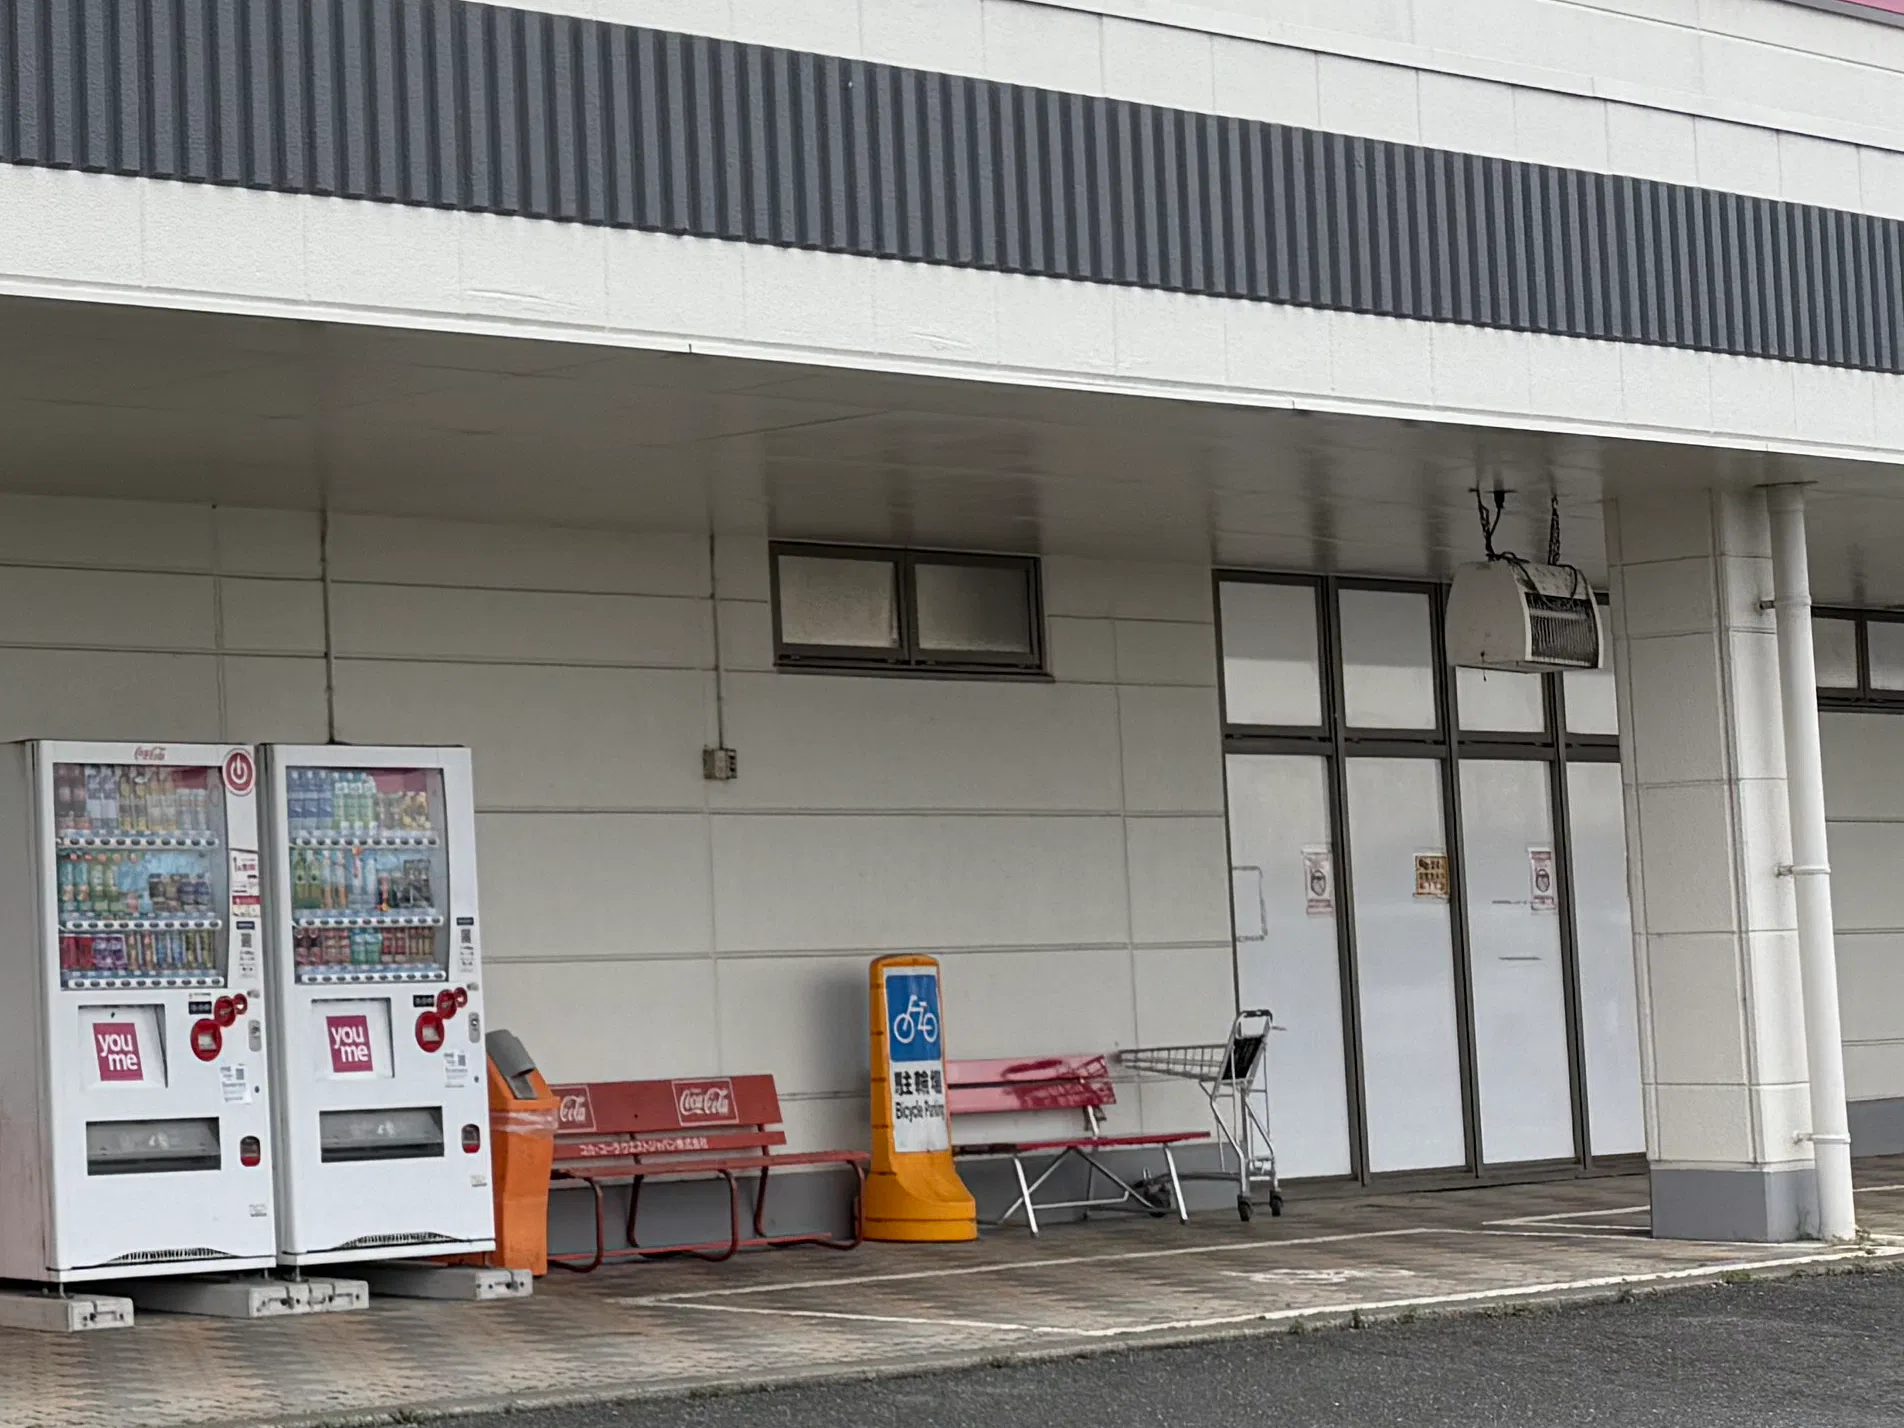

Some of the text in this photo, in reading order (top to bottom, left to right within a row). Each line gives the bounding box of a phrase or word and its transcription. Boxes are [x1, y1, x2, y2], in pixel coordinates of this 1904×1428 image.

[98, 1033, 133, 1057] you
[331, 1026, 365, 1048] you
[108, 1052, 138, 1071] me
[340, 1045, 369, 1063] me
[559, 1095, 587, 1123] Cola
